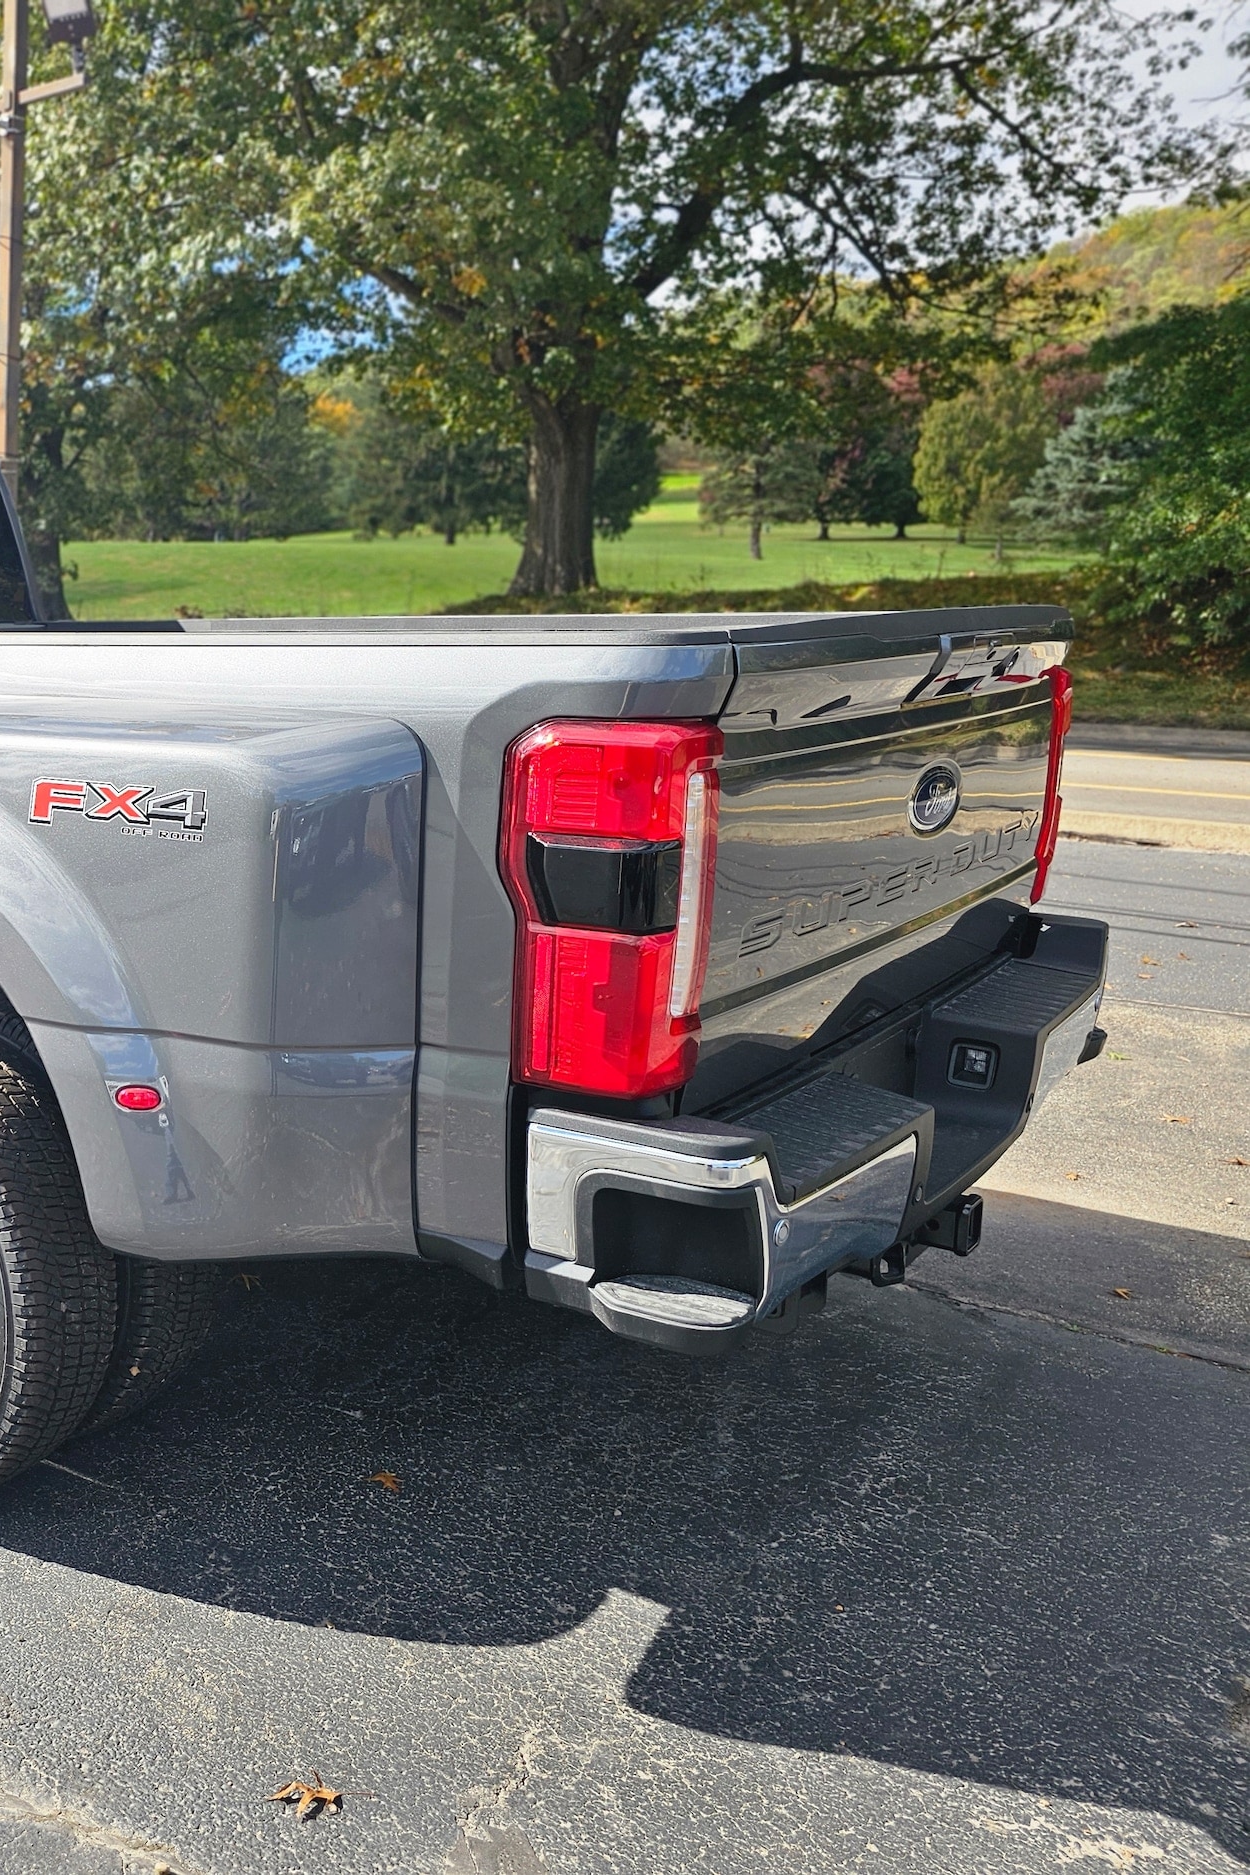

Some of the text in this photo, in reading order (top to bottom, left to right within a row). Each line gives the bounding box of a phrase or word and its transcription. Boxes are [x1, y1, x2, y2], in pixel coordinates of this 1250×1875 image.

[28, 777, 208, 831] FX4
[924, 783, 954, 816] Ford
[120, 826, 204, 842] OFF ROAD
[738, 809, 1040, 958] SUPER DUTY
